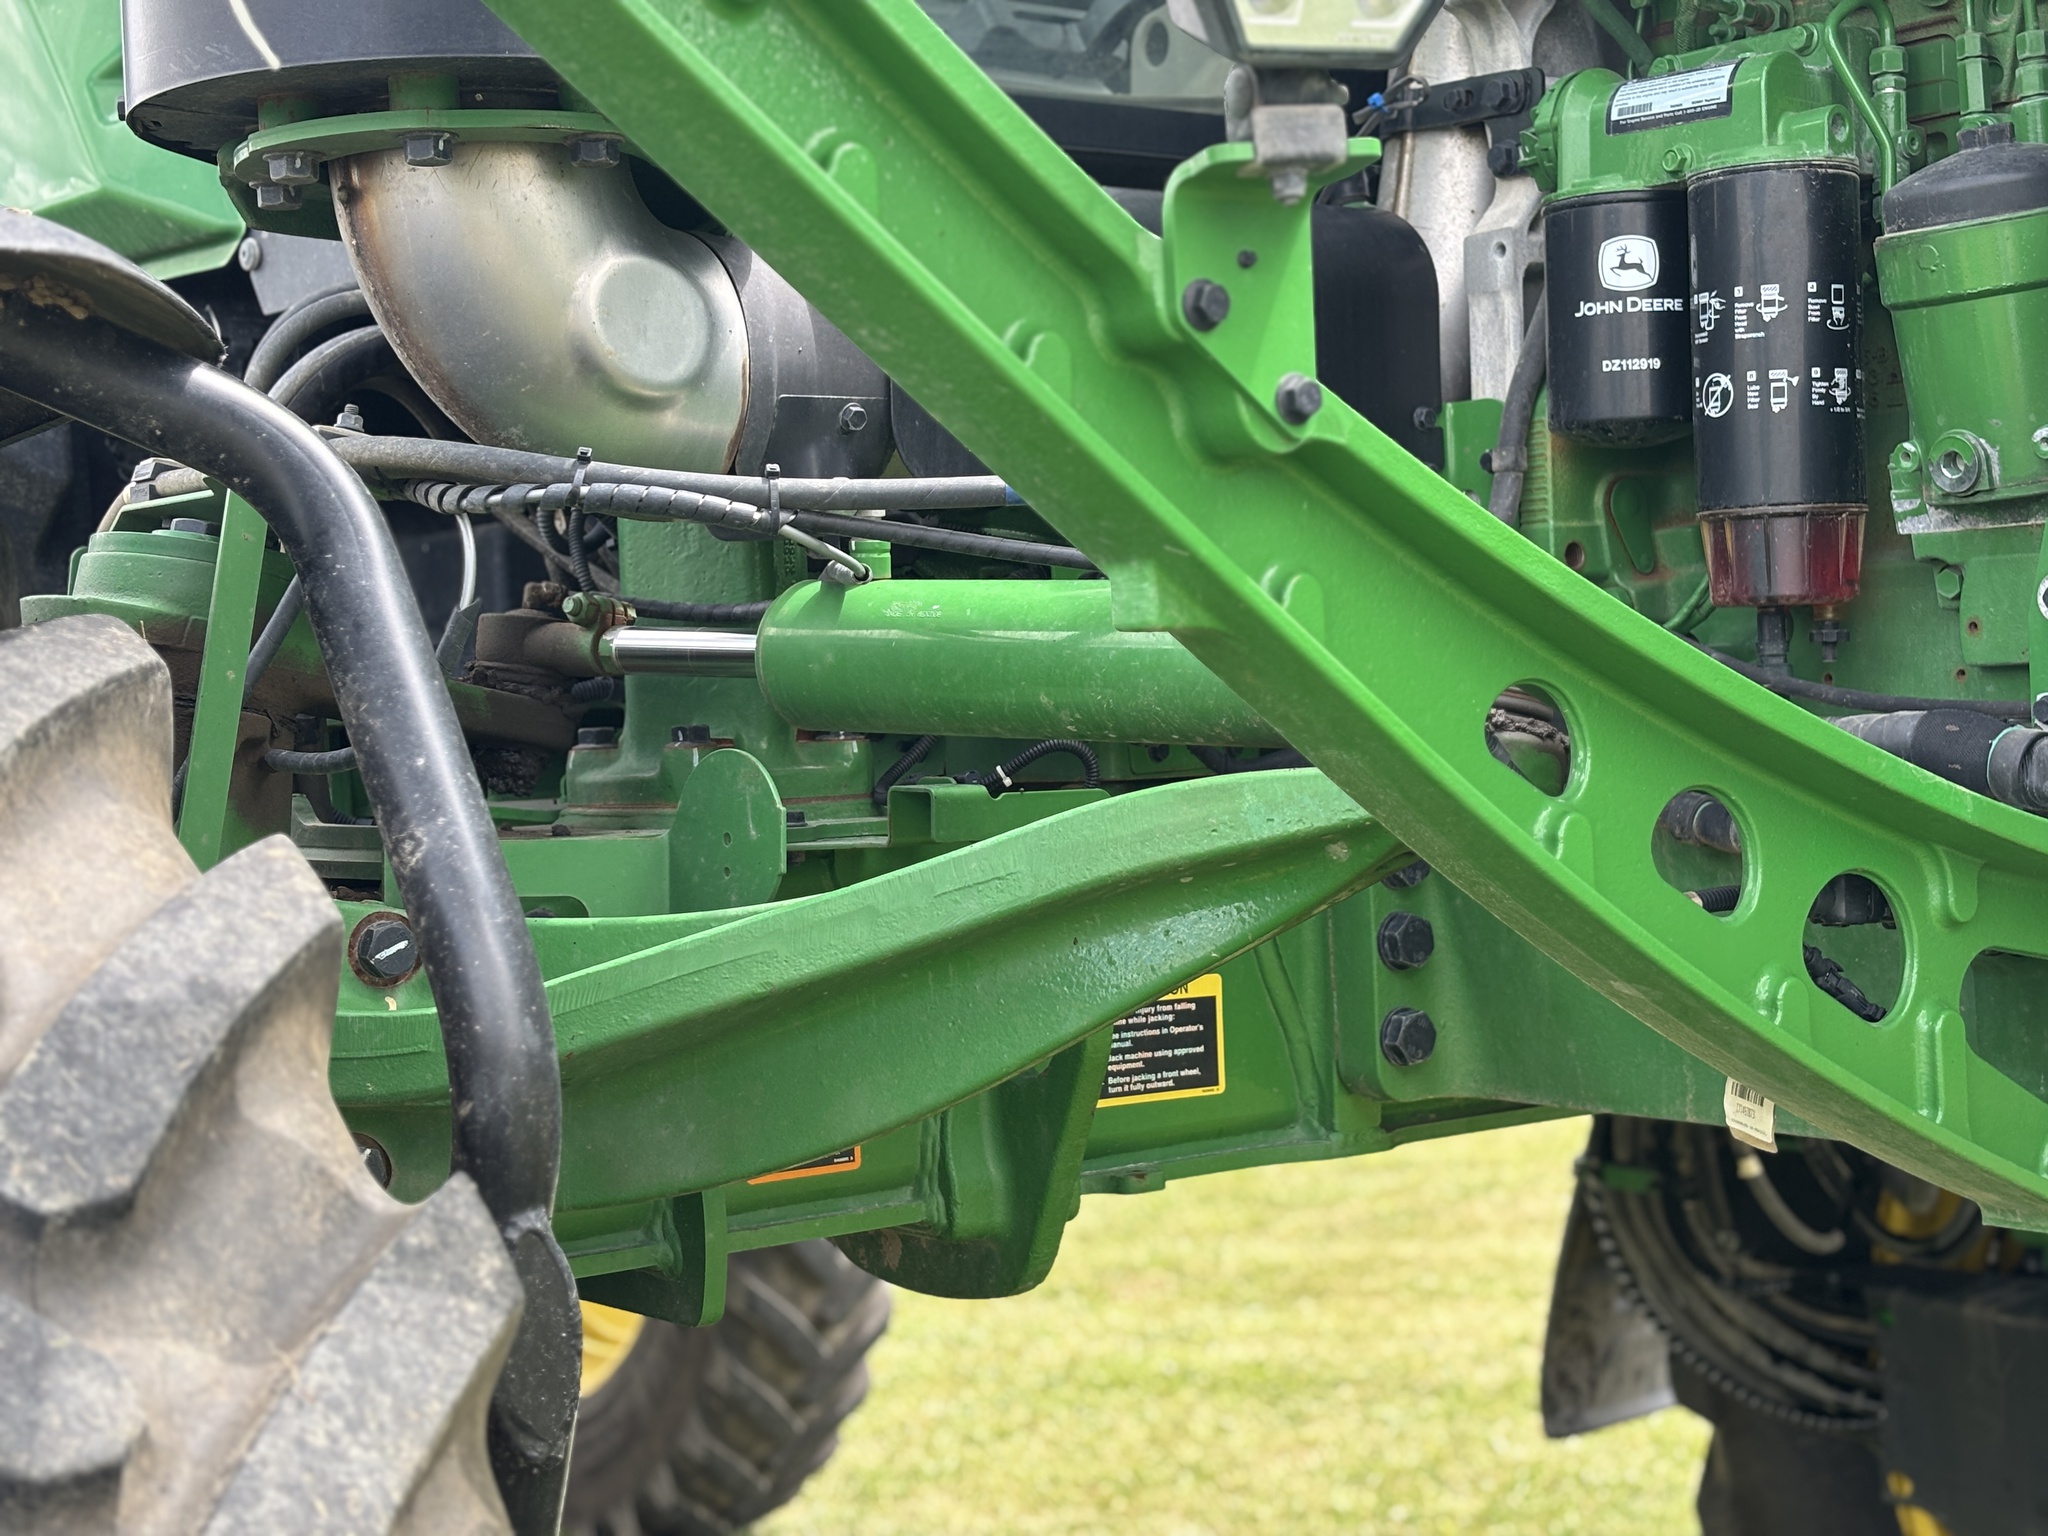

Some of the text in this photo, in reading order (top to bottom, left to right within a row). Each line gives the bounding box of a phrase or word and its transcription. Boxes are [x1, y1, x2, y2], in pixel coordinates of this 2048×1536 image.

[1574, 300, 1623, 318] JOHN
[1626, 296, 1684, 313] DEERE
[1601, 357, 1661, 372] DZ112919
[1156, 1004, 1173, 1012] from
[1174, 1001, 1196, 1011] falling
[1127, 1015, 1147, 1024] while
[1147, 1013, 1176, 1024] jacking:
[1120, 1028, 1160, 1039] instructions
[1161, 1026, 1169, 1034] in
[1169, 1024, 1204, 1035] Operator's
[1124, 1051, 1153, 1060] machine
[1153, 1049, 1173, 1058] using
[1173, 1045, 1205, 1056] approved
[1107, 1061, 1145, 1072] equipment.
[1108, 1076, 1130, 1085] Before
[1131, 1073, 1156, 1084] jacking
[1162, 1070, 1179, 1078] front
[1180, 1067, 1201, 1076] wheel,
[1130, 1083, 1145, 1092] fully
[1146, 1079, 1175, 1089] outward.
